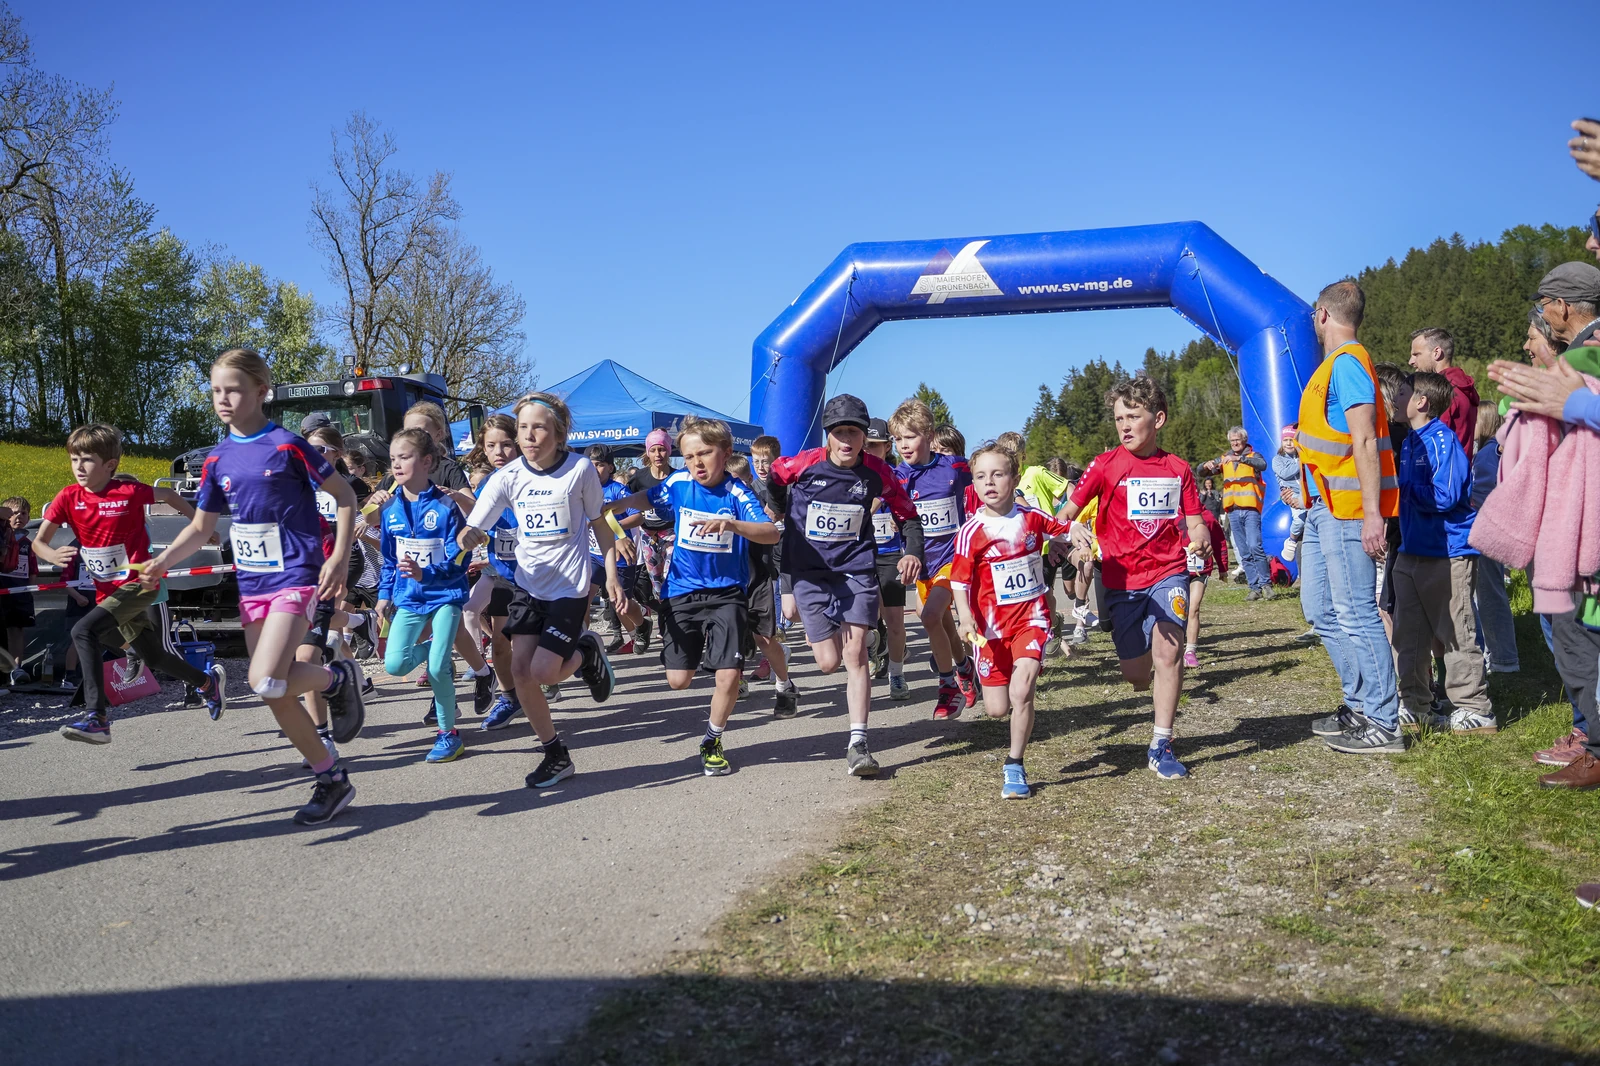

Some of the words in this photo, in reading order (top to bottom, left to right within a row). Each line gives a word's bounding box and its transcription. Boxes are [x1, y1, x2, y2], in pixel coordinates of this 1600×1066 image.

[936, 274, 988, 283] MAIERHÖFEN
[936, 282, 990, 292] GRÜNENBACH
[1018, 277, 1133, 295] www.sv-mg.de
[289, 385, 330, 398] LEITNER
[567, 426, 639, 440] ww.sv-mg.de
[528, 489, 553, 497] Zeus
[1138, 491, 1170, 507] 61-1
[98, 500, 129, 509] PFAFF
[317, 501, 331, 513] 9-1
[525, 511, 558, 529] 82-1
[816, 515, 851, 530] 66-1
[921, 510, 951, 526] 96-1
[236, 539, 268, 558] 93-1
[499, 539, 517, 551] 77-
[88, 558, 118, 572] 63-1
[1004, 567, 1039, 590] 40-1
[546, 626, 572, 643] Zeus
